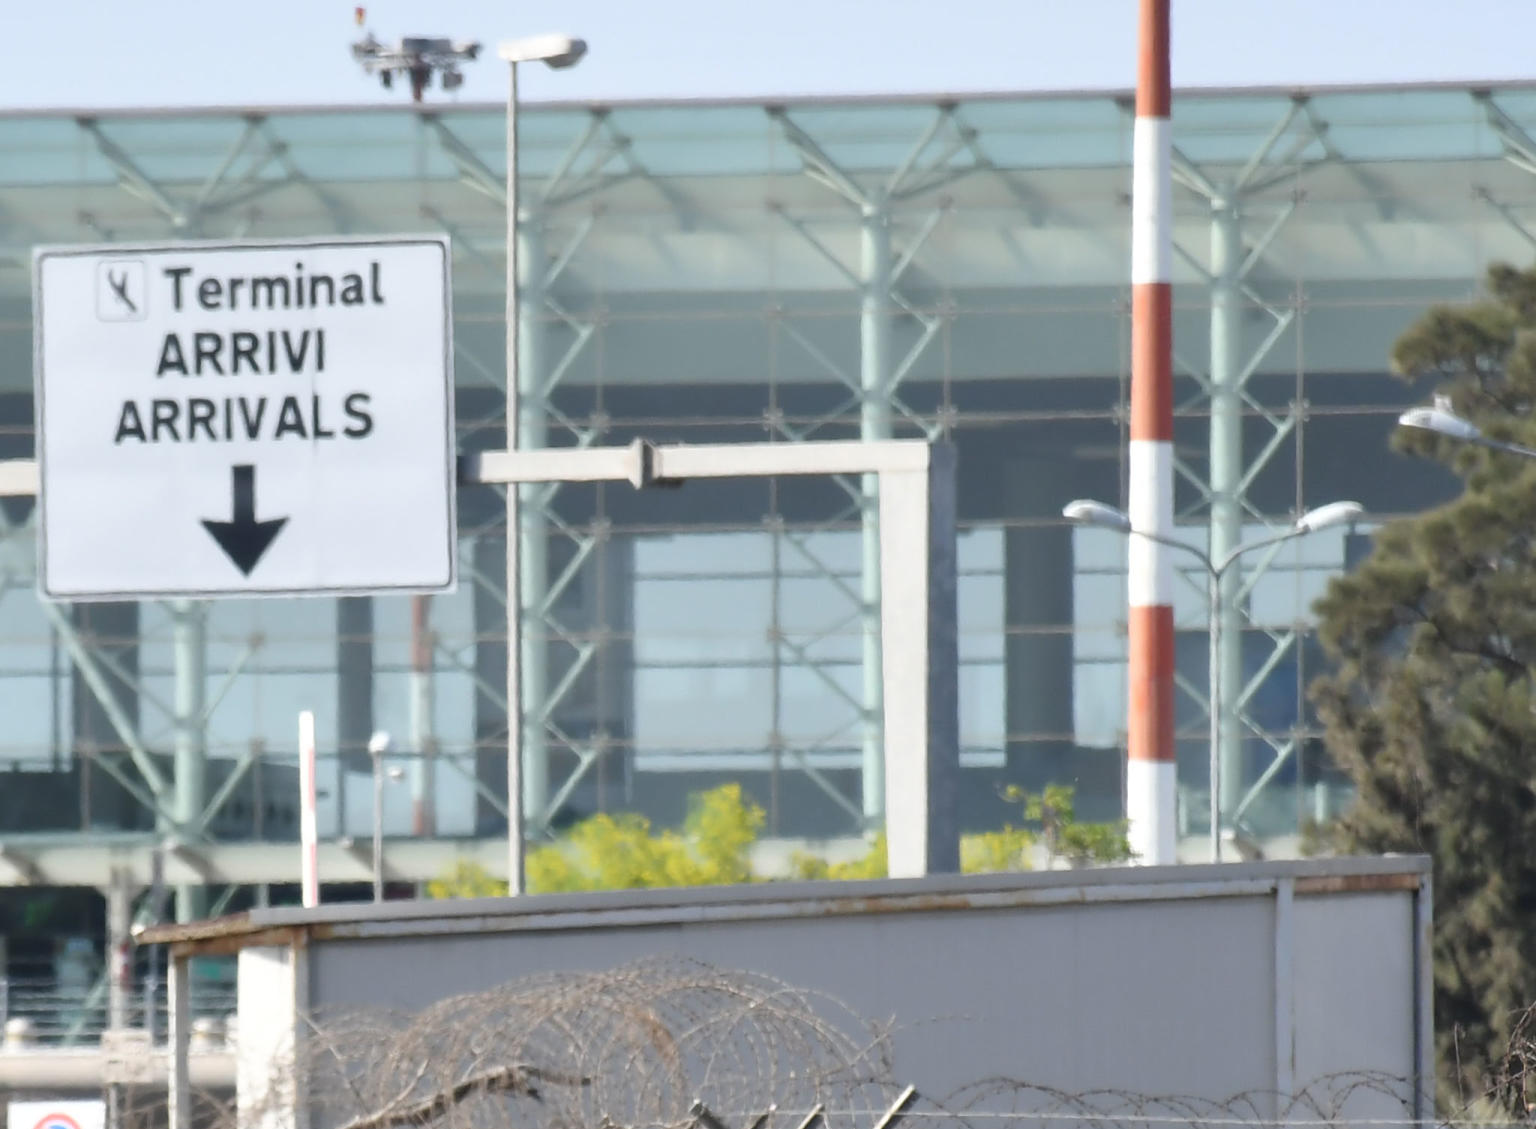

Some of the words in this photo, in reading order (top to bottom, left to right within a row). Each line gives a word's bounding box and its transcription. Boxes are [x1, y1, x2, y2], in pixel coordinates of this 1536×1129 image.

[162, 261, 385, 312] Terminal
[154, 330, 326, 377] ARRIVI
[113, 392, 374, 444] ARRIVALS
